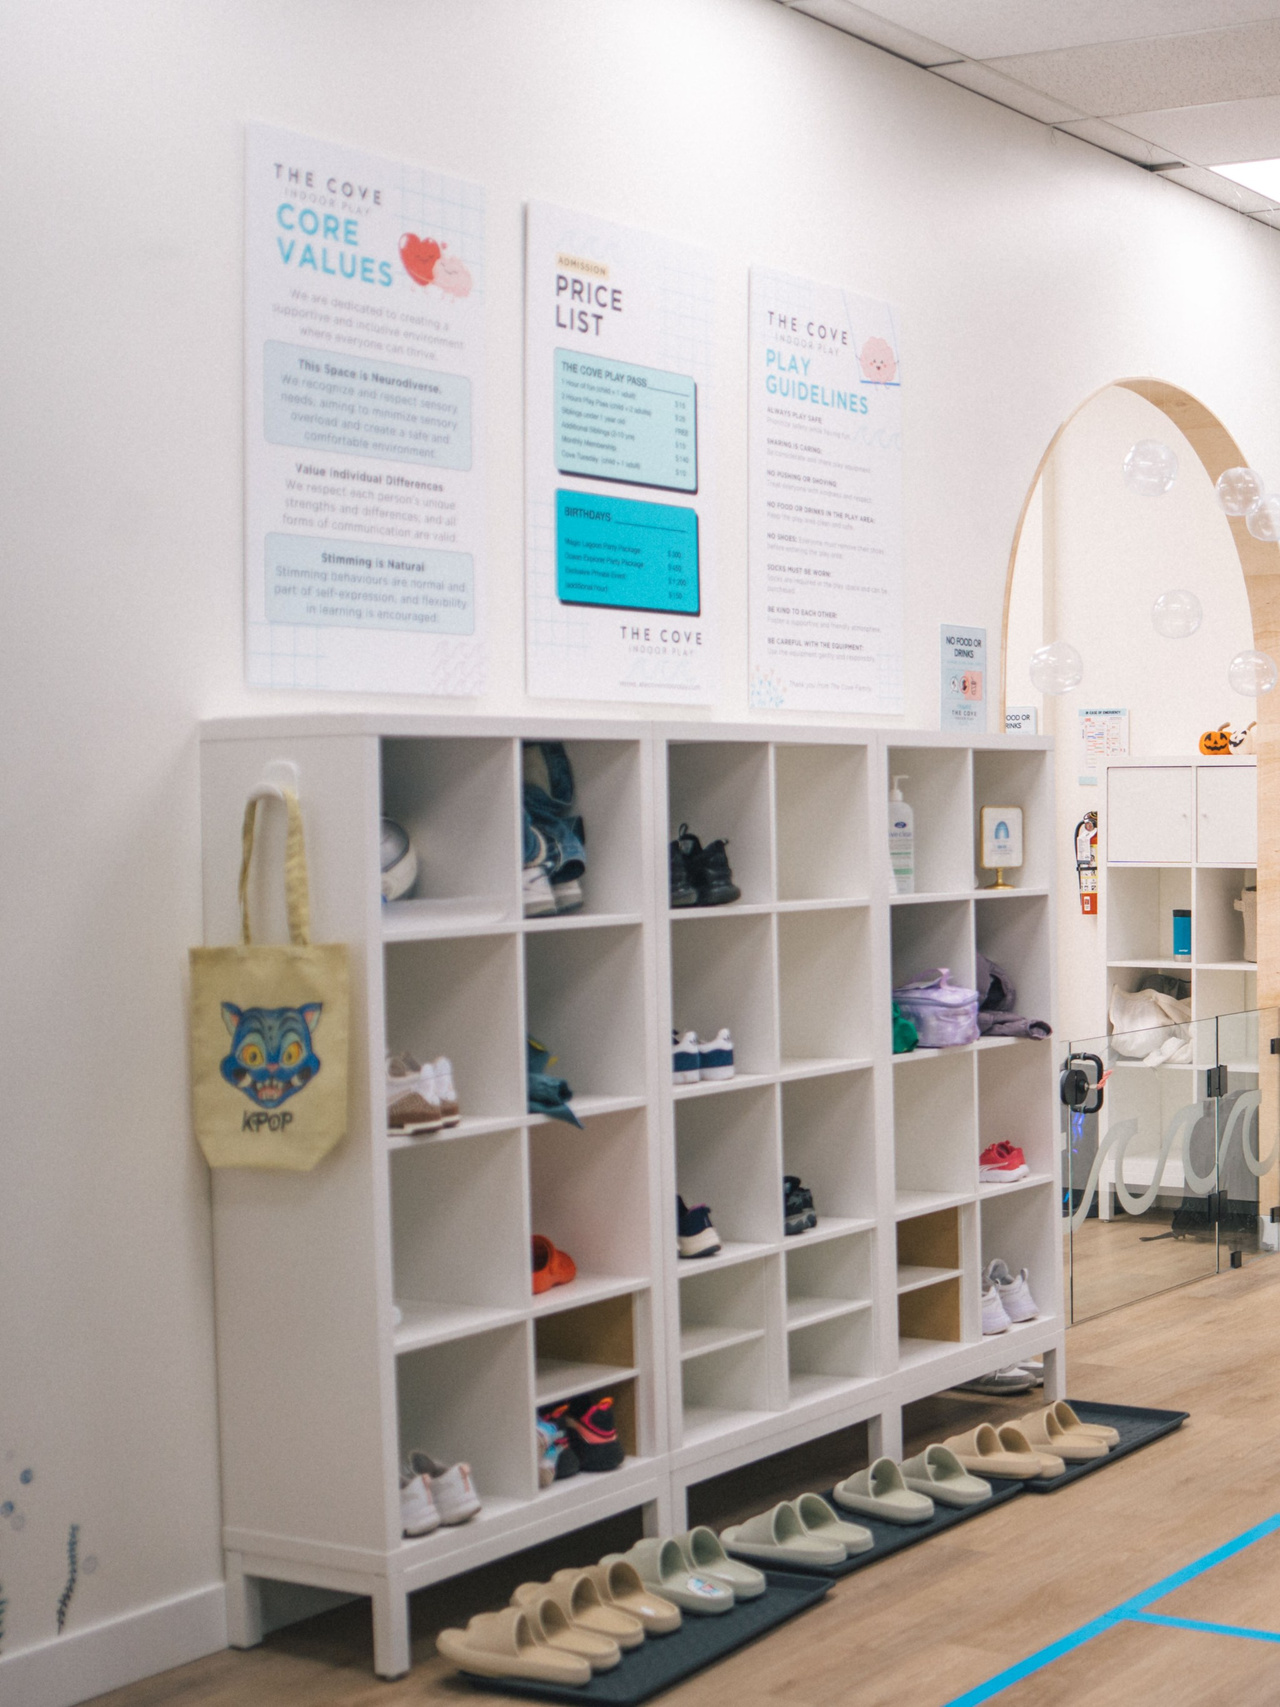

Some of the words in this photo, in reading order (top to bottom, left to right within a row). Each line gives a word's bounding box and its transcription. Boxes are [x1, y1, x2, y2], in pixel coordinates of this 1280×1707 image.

[273, 161, 314, 188] THE
[326, 177, 382, 206] COVE
[275, 202, 359, 247] CORE
[275, 236, 393, 288] VALUES
[557, 255, 607, 276] ADMISSION
[555, 273, 623, 313] PRICE
[555, 303, 605, 337] LIST
[767, 310, 798, 333] THE
[806, 321, 848, 346] COVE
[298, 358, 321, 374] This
[324, 363, 357, 382] Space
[360, 370, 369, 382] is
[765, 347, 811, 377] PLAY
[561, 361, 578, 375] THE
[579, 364, 604, 380] COVE
[604, 369, 626, 384] PLAY
[626, 374, 648, 389] PASS
[764, 373, 869, 415] GUIDELINES
[766, 406, 791, 418] ALWAYS
[792, 411, 807, 421] PLAY
[766, 437, 792, 450] SHARING
[793, 442, 799, 450] IS
[295, 462, 327, 478] Value
[330, 466, 380, 485] Individual
[385, 475, 445, 493] Differences
[766, 469, 776, 478] NO
[777, 471, 802, 482] PUSHING
[802, 475, 811, 483] OR
[285, 479, 304, 492] We
[306, 483, 347, 498] respect
[350, 489, 375, 501] each
[422, 497, 457, 512] unique
[284, 497, 337, 515] strengths
[339, 504, 359, 516] and
[424, 513, 443, 526] and
[445, 516, 457, 528] all
[563, 506, 612, 522] BIRTHDAYS
[766, 501, 776, 509] NO
[777, 502, 794, 511] FOOD
[794, 504, 803, 513] OR
[804, 507, 825, 516] DRINKS
[833, 511, 844, 519] THE
[845, 513, 858, 521] PLAY
[766, 533, 776, 541] NO
[321, 552, 372, 570] Stimming
[374, 558, 384, 569] is
[387, 559, 426, 573] Natural
[766, 563, 787, 574] SOCKS
[787, 566, 803, 575] MUST
[803, 568, 811, 576] BE
[766, 605, 775, 614] BE
[776, 606, 791, 616] KIND
[792, 608, 800, 616] TO
[801, 608, 817, 618] EACH
[619, 625, 651, 642] THE
[660, 629, 703, 646] COVE
[766, 637, 776, 645] BE
[776, 637, 803, 648] CAREFUL
[803, 640, 819, 649] WITH
[820, 641, 831, 650] THE
[945, 636, 956, 646] NO
[956, 636, 973, 648] FOOD
[973, 639, 983, 649] OR
[954, 648, 975, 659] DRINKS
[951, 709, 963, 717] THE
[1005, 714, 1021, 722] OOD
